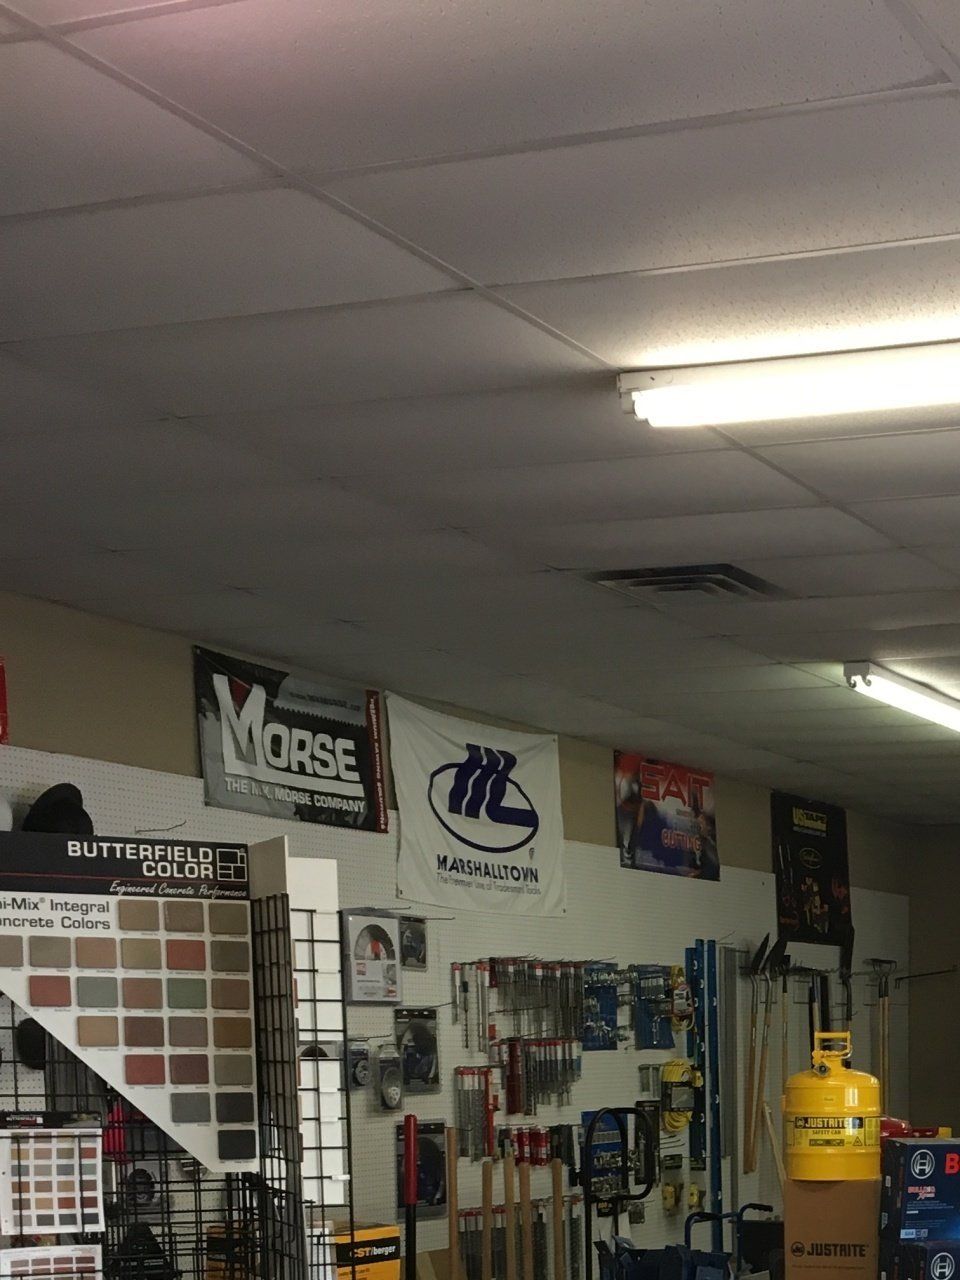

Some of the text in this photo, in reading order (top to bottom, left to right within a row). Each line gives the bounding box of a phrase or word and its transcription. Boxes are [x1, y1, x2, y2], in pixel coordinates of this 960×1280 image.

[213, 673, 360, 782] MORSE
[225, 778, 367, 812] THE MORSE COMPANY
[640, 761, 711, 811] SAIT
[67, 840, 213, 863] BUTTERFIELD
[142, 861, 213, 879] COLOR
[437, 854, 539, 883] MARSHALLTOWN
[109, 880, 248, 900] Engineered Concrete Performance
[50, 899, 110, 915] Integral
[0, 916, 111, 930] ncrete Colors
[807, 1243, 866, 1257] JUSTRITE
